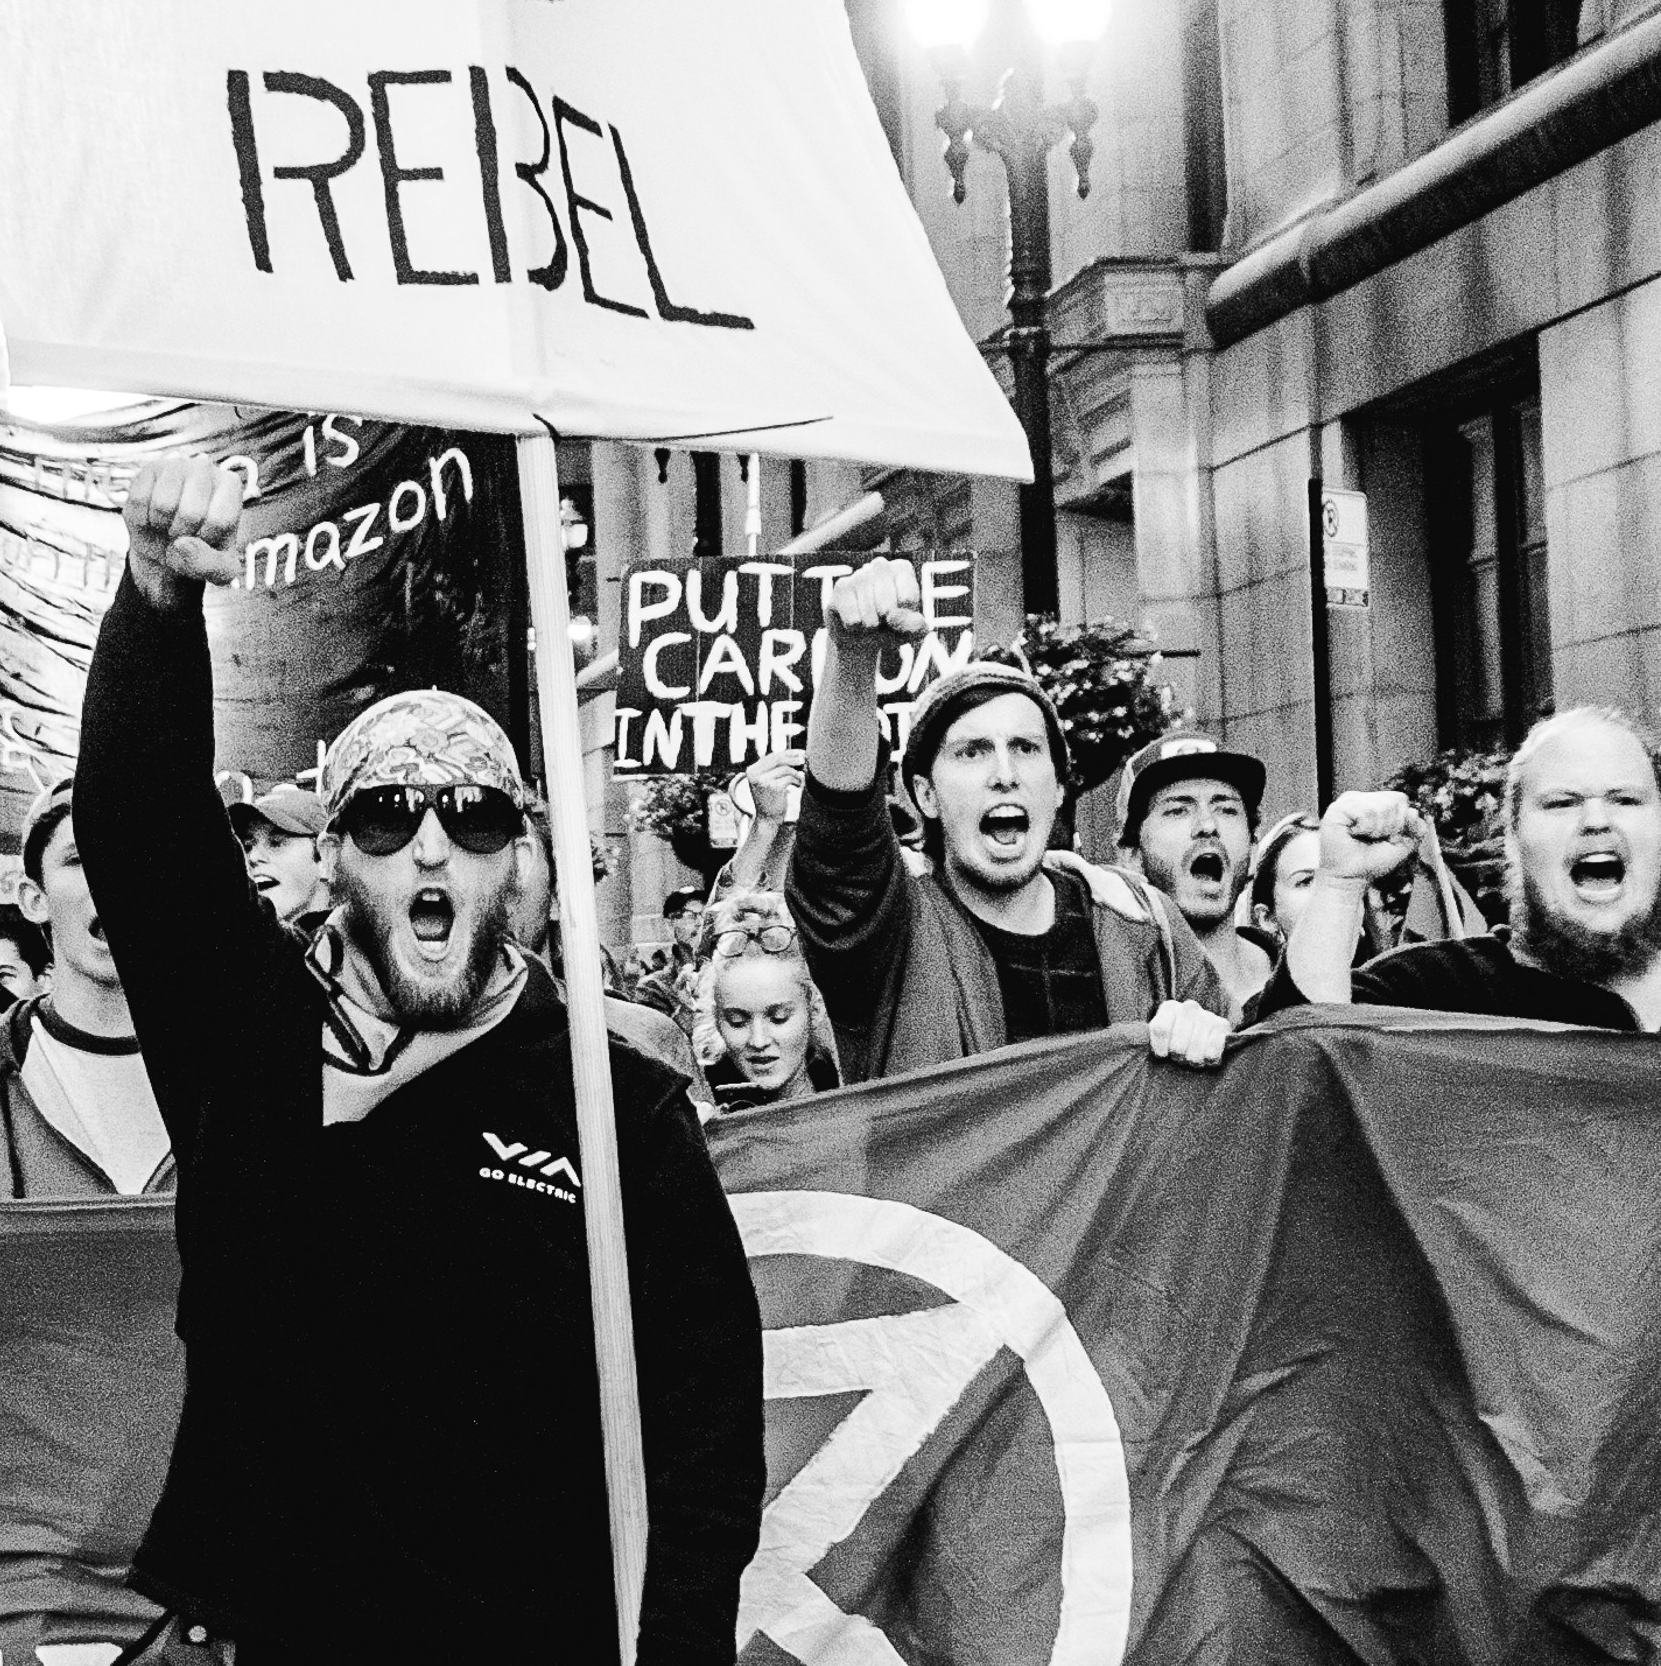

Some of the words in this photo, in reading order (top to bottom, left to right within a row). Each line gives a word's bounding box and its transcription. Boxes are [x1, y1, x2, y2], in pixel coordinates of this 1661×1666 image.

[226, 64, 756, 331] REBEL
[231, 447, 473, 591] mazon
[629, 562, 793, 649] PUT
[802, 560, 973, 630] TE
